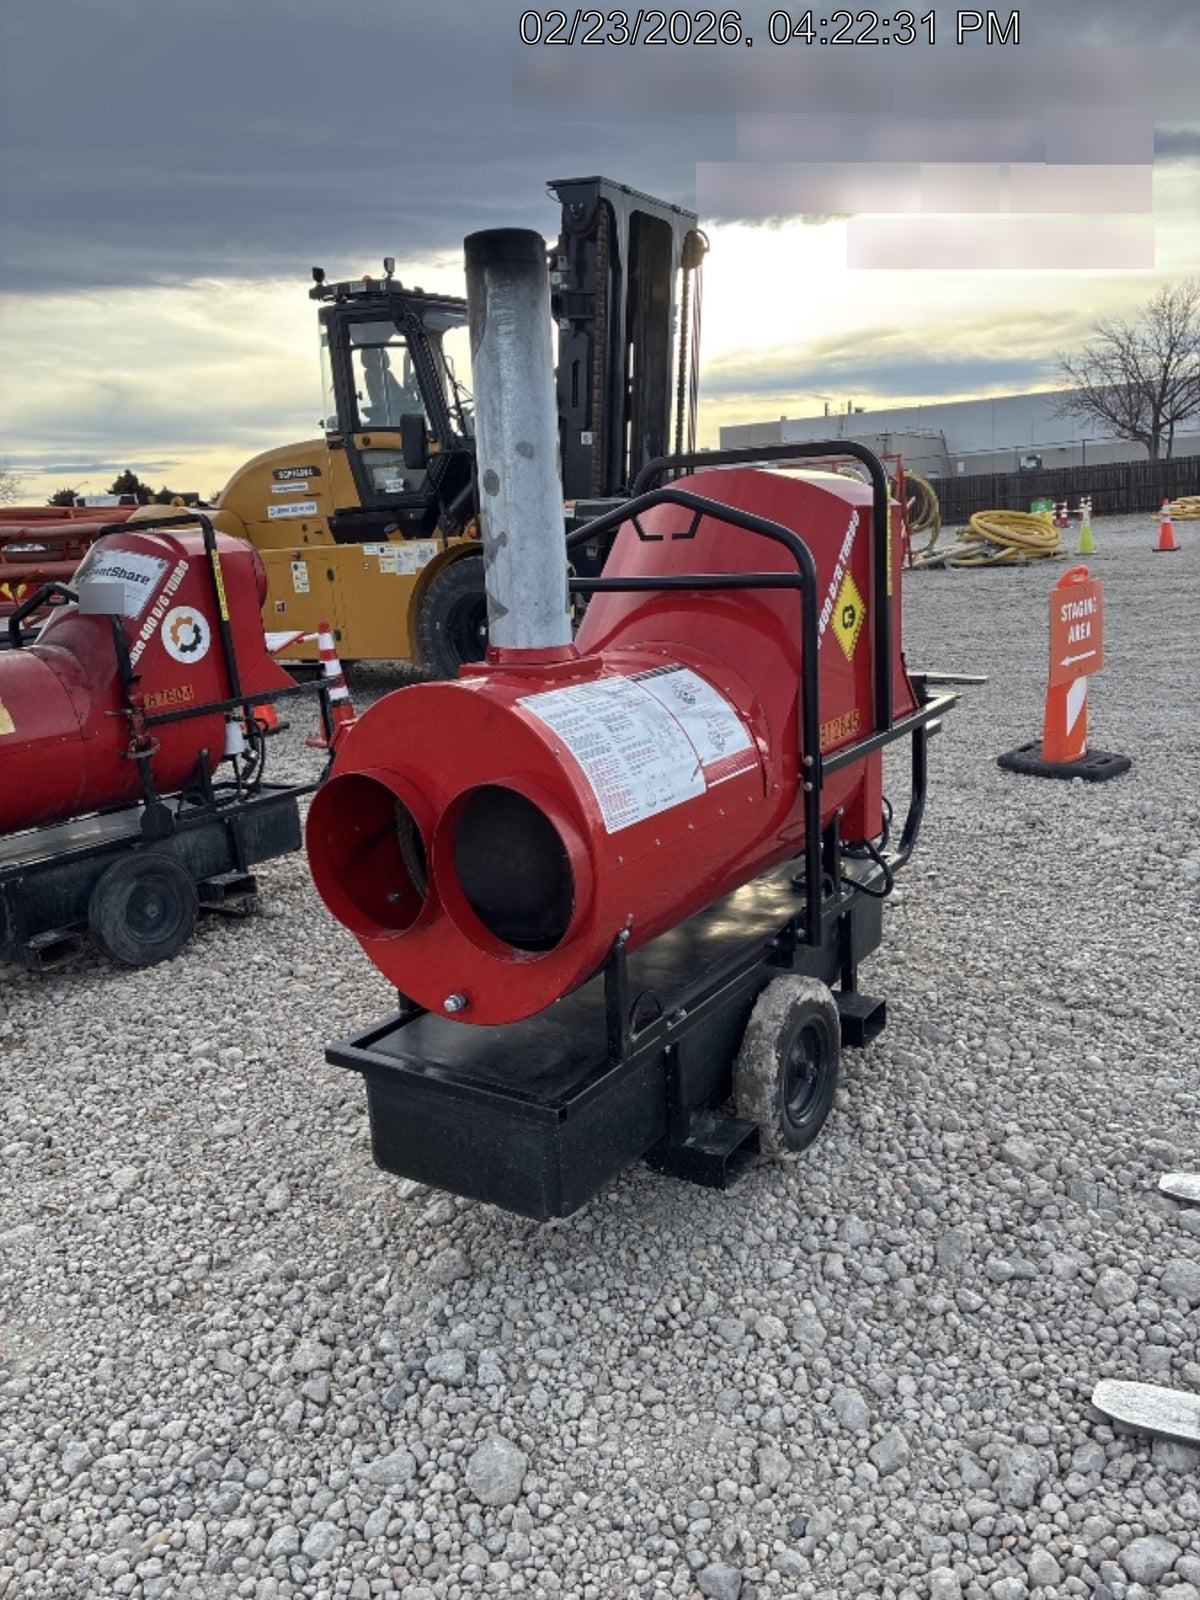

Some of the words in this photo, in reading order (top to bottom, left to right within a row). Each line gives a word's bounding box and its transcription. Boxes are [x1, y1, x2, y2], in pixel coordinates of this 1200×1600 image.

[839, 510, 860, 565] TURBO
[140, 617, 158, 640] 400
[163, 560, 189, 596] TURBO
[1068, 621, 1091, 644] AREA
